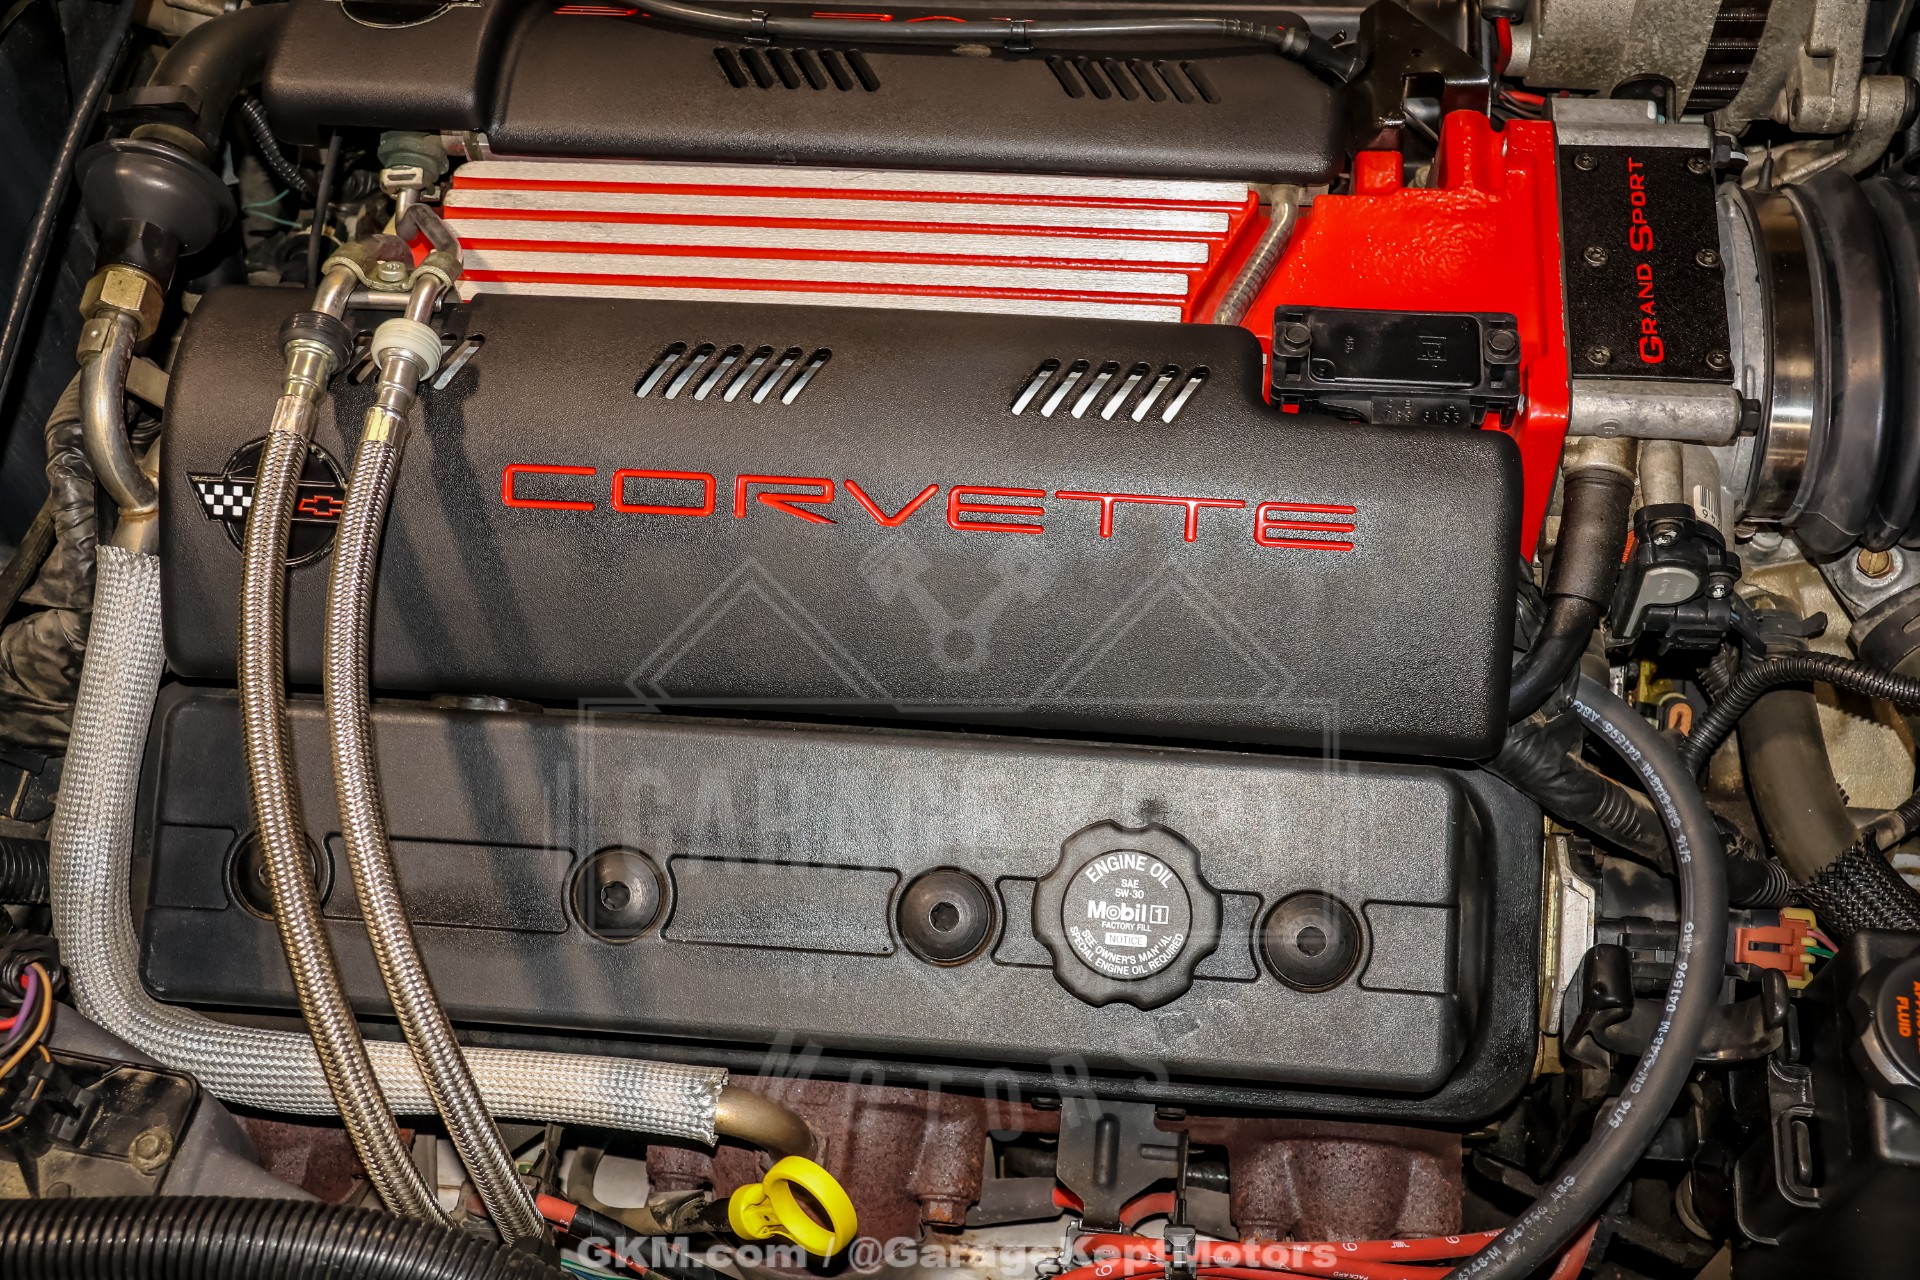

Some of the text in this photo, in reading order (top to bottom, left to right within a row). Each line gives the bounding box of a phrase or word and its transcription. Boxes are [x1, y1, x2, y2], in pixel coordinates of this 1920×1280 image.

[1628, 157, 1665, 364] GRAND SPORT
[502, 463, 1358, 551] CORVETTE
[1085, 854, 1174, 889] ENGINE OIL
[1121, 879, 1139, 889] SAE
[1115, 888, 1144, 899] 5W-30
[1087, 900, 1147, 923] Mobil
[1101, 921, 1152, 932] FACTORY FILL
[1070, 925, 1184, 976] SPECIAL ENGINE OIL REQUIRED
[1082, 929, 1097, 948] SEE
[1096, 945, 1136, 965] OWNER'S
[1109, 934, 1144, 946] NOTICE
[1896, 996, 1912, 1038] FLUID
[1609, 1099, 1632, 1129] 5/16
[1665, 962, 1689, 1013] 041596
